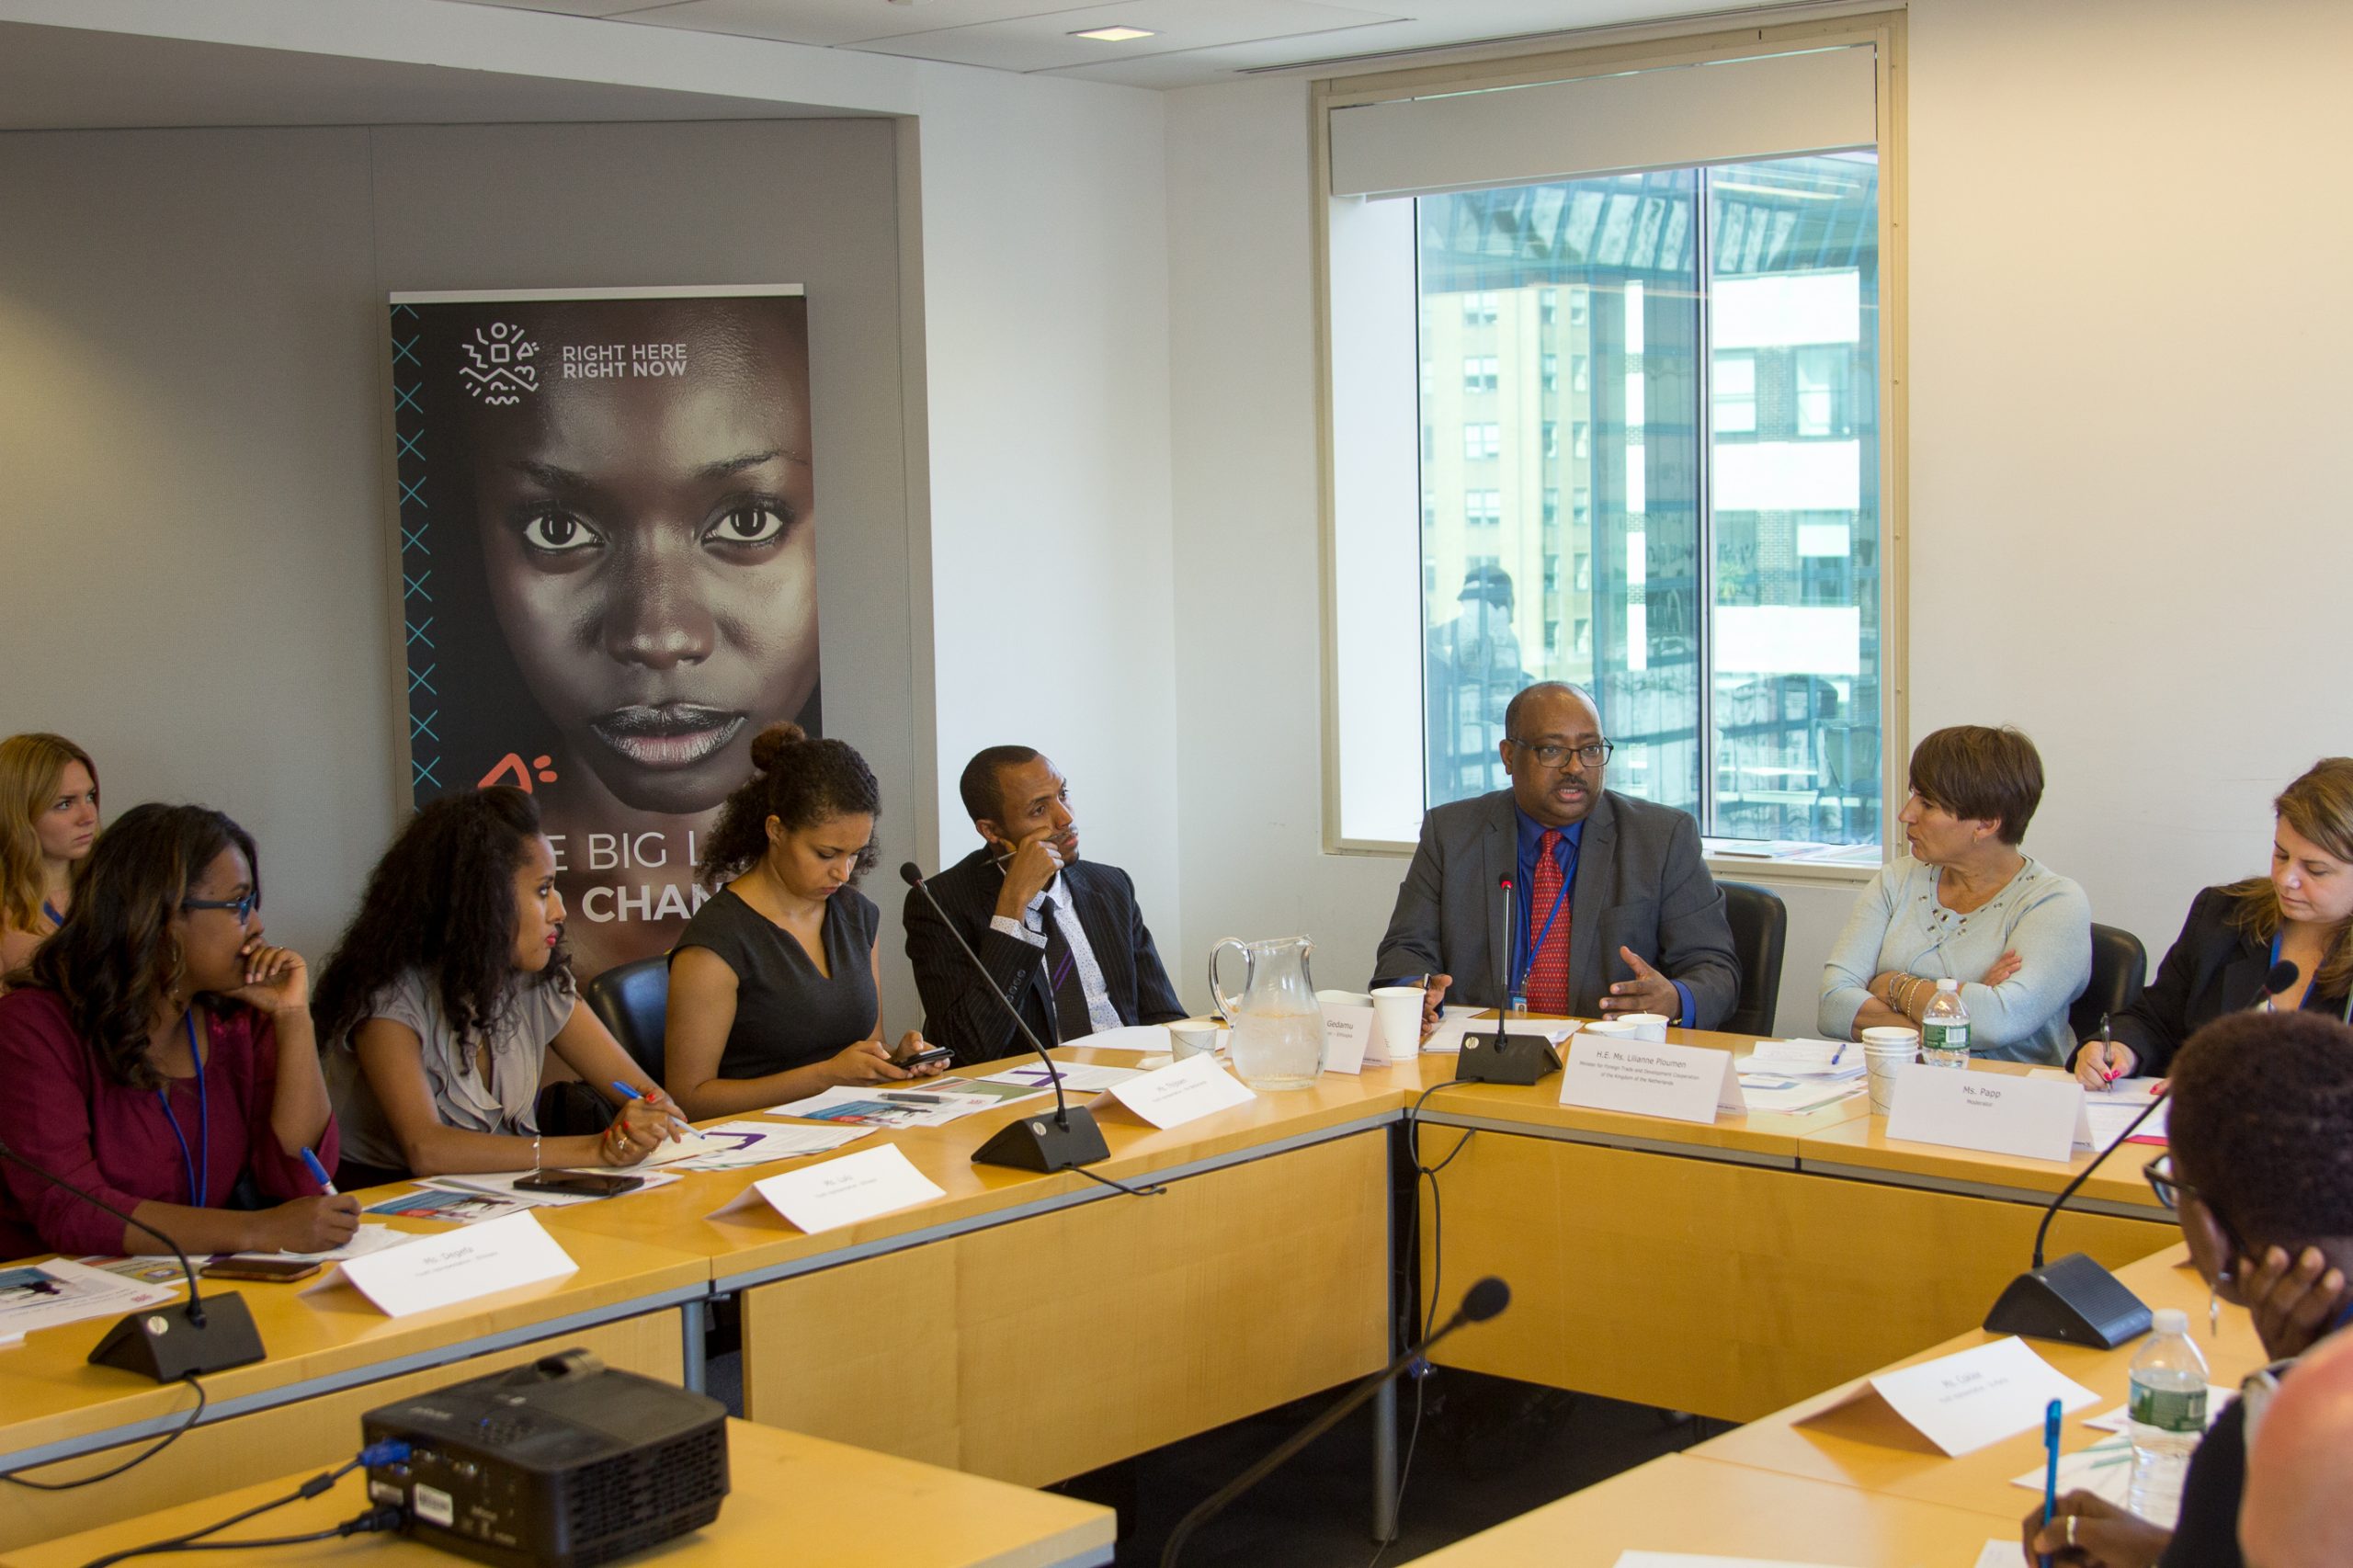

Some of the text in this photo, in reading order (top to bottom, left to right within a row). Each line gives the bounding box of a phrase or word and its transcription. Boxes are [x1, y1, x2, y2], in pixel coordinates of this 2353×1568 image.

[563, 344, 688, 361] RIGHT HERE
[563, 360, 688, 379] RIGHT NOW
[588, 831, 667, 870] BIG
[1326, 1019, 1354, 1030] Gedamu
[1613, 1052, 1624, 1061] Ms.
[1627, 1054, 1654, 1064] Lilianne
[1655, 1057, 1687, 1068] Ploumen
[1962, 1085, 2001, 1099] Ms. Papp
